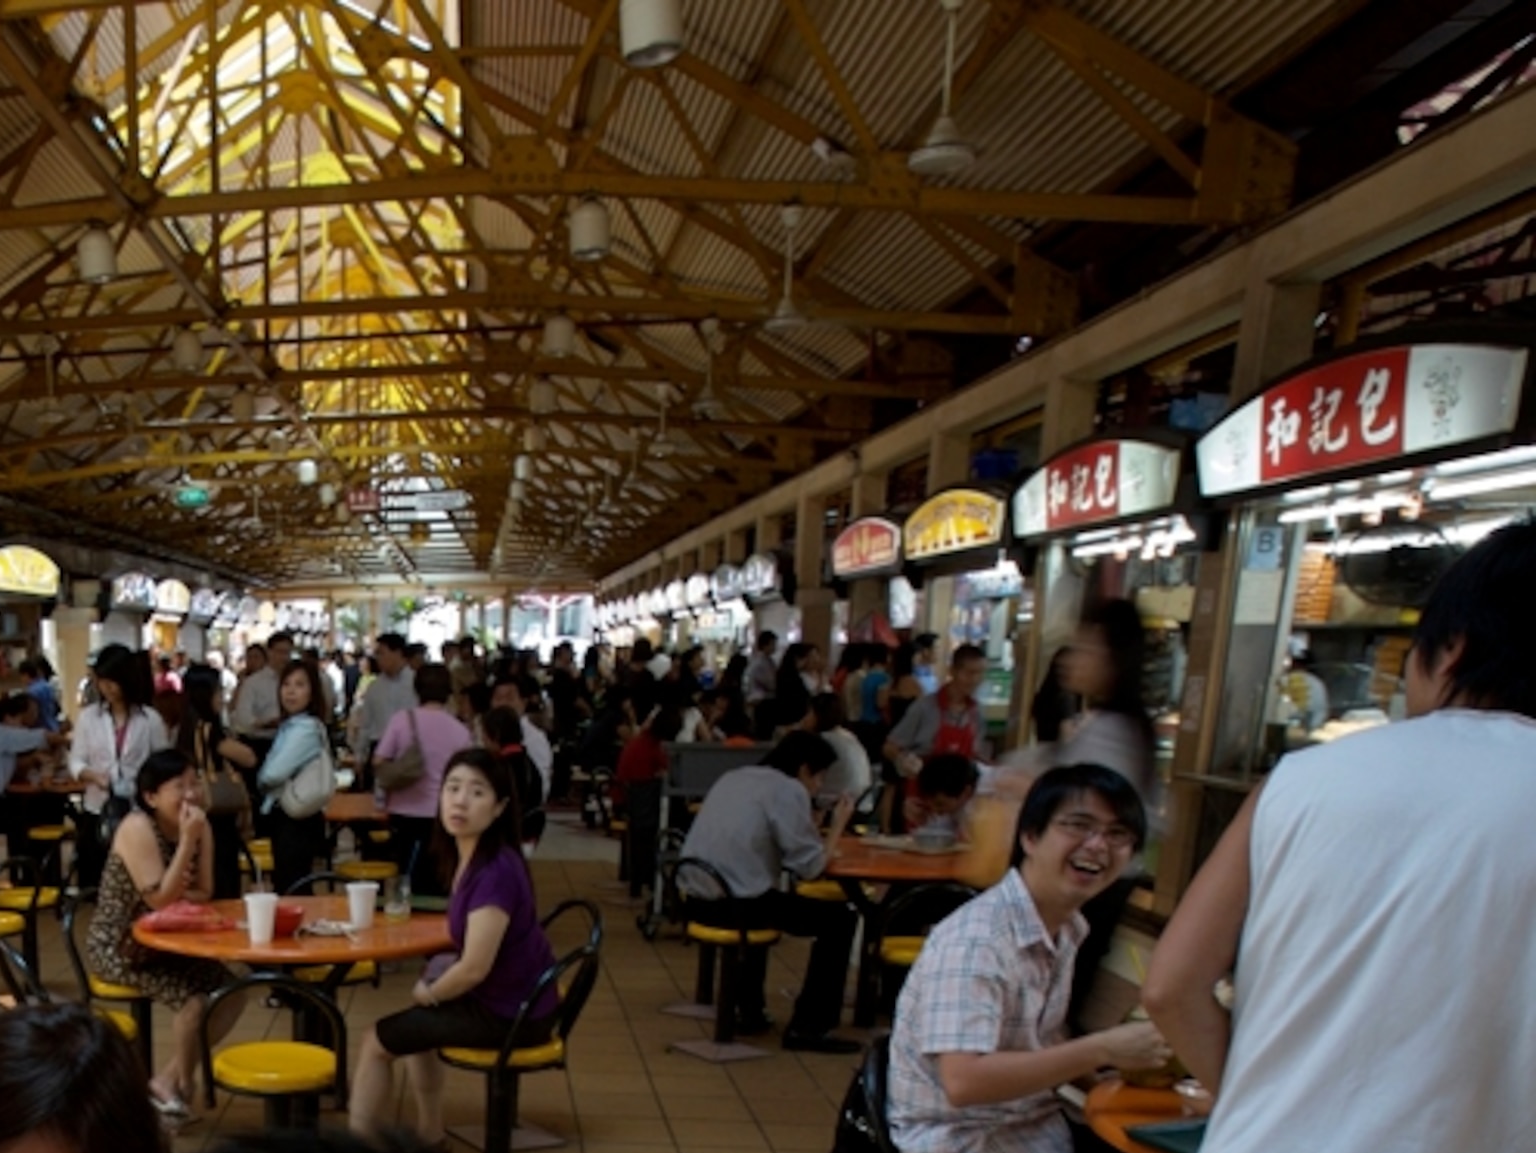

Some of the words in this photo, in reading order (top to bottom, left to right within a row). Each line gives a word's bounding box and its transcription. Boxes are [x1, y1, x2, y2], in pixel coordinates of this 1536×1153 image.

[1266, 366, 1399, 467] 和記包
[1257, 530, 1276, 554] B
